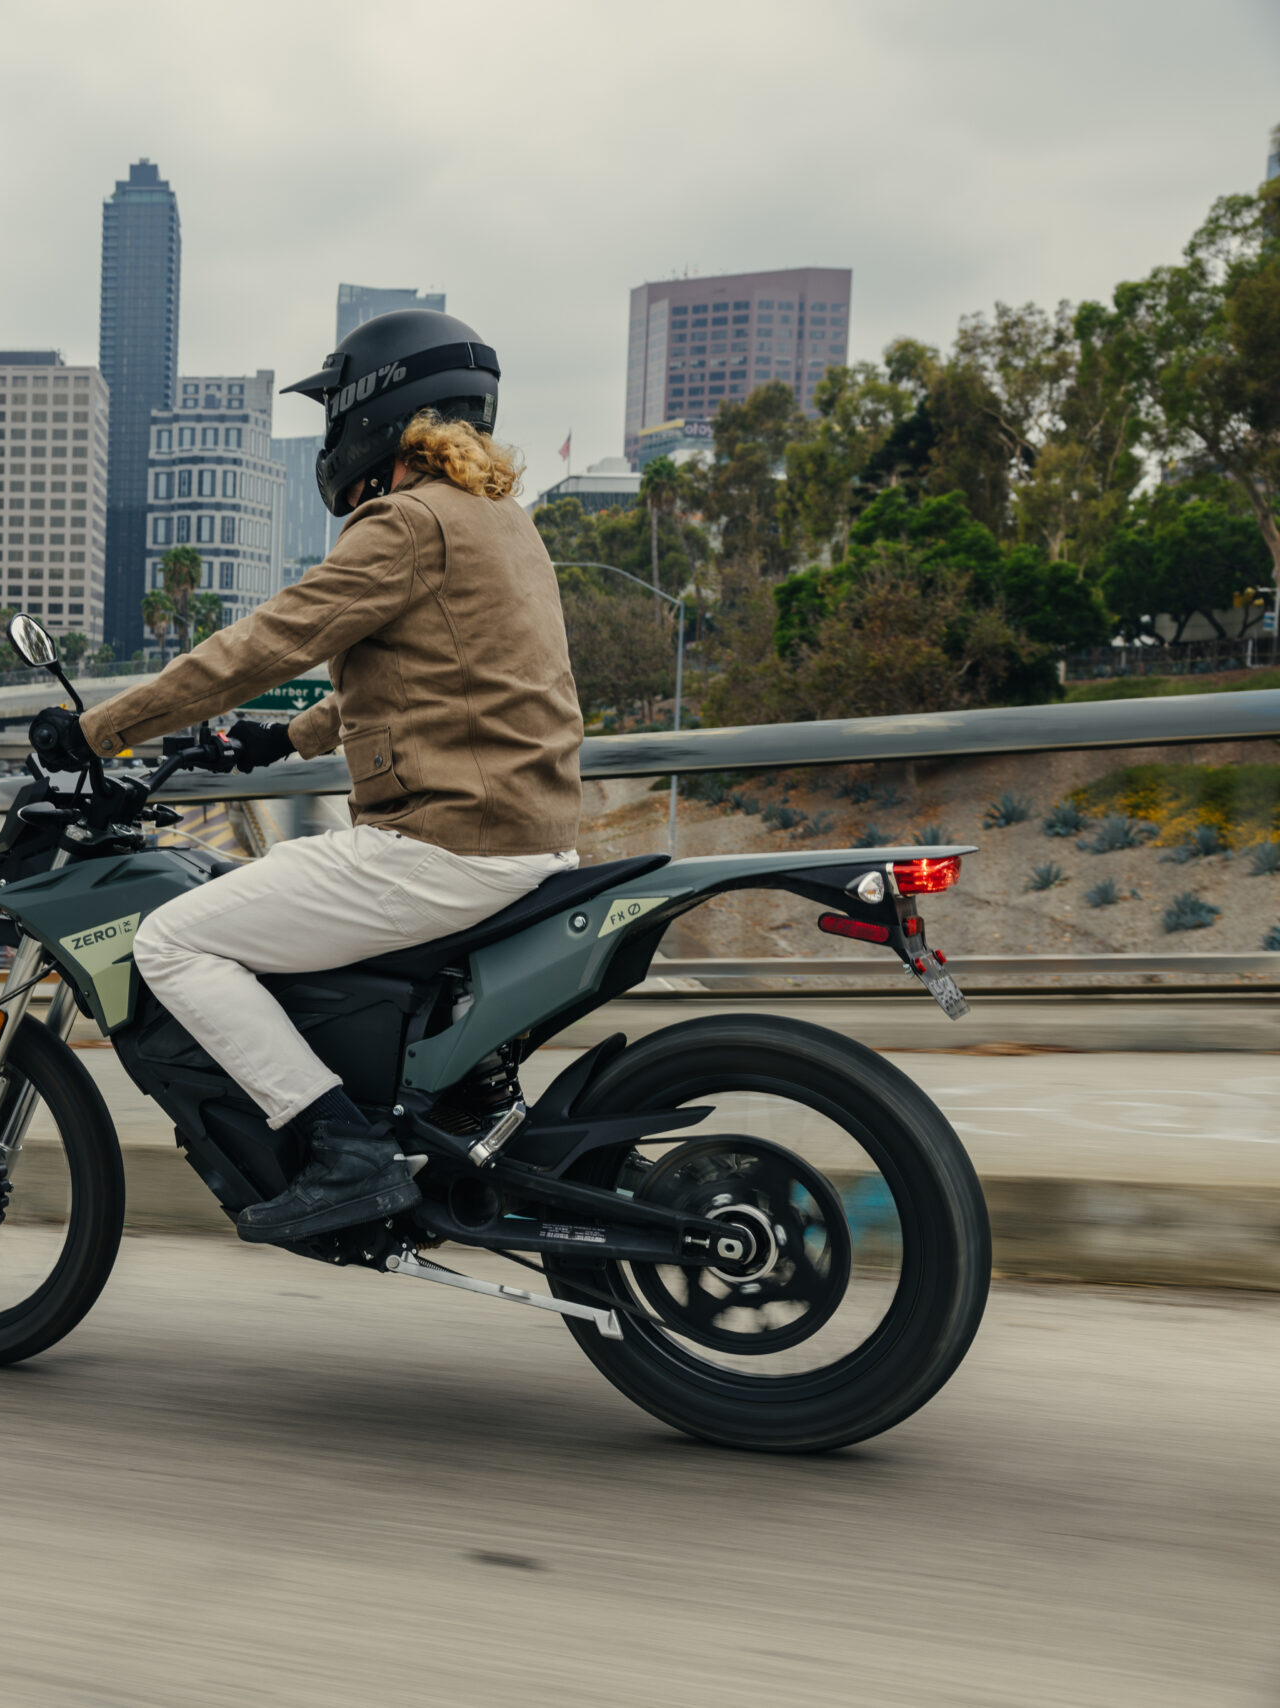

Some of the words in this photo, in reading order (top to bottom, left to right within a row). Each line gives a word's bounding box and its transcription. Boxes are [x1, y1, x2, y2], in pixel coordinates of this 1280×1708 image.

[330, 361, 407, 418] 100%
[71, 926, 117, 950] ZERO
[122, 920, 133, 933] FX
